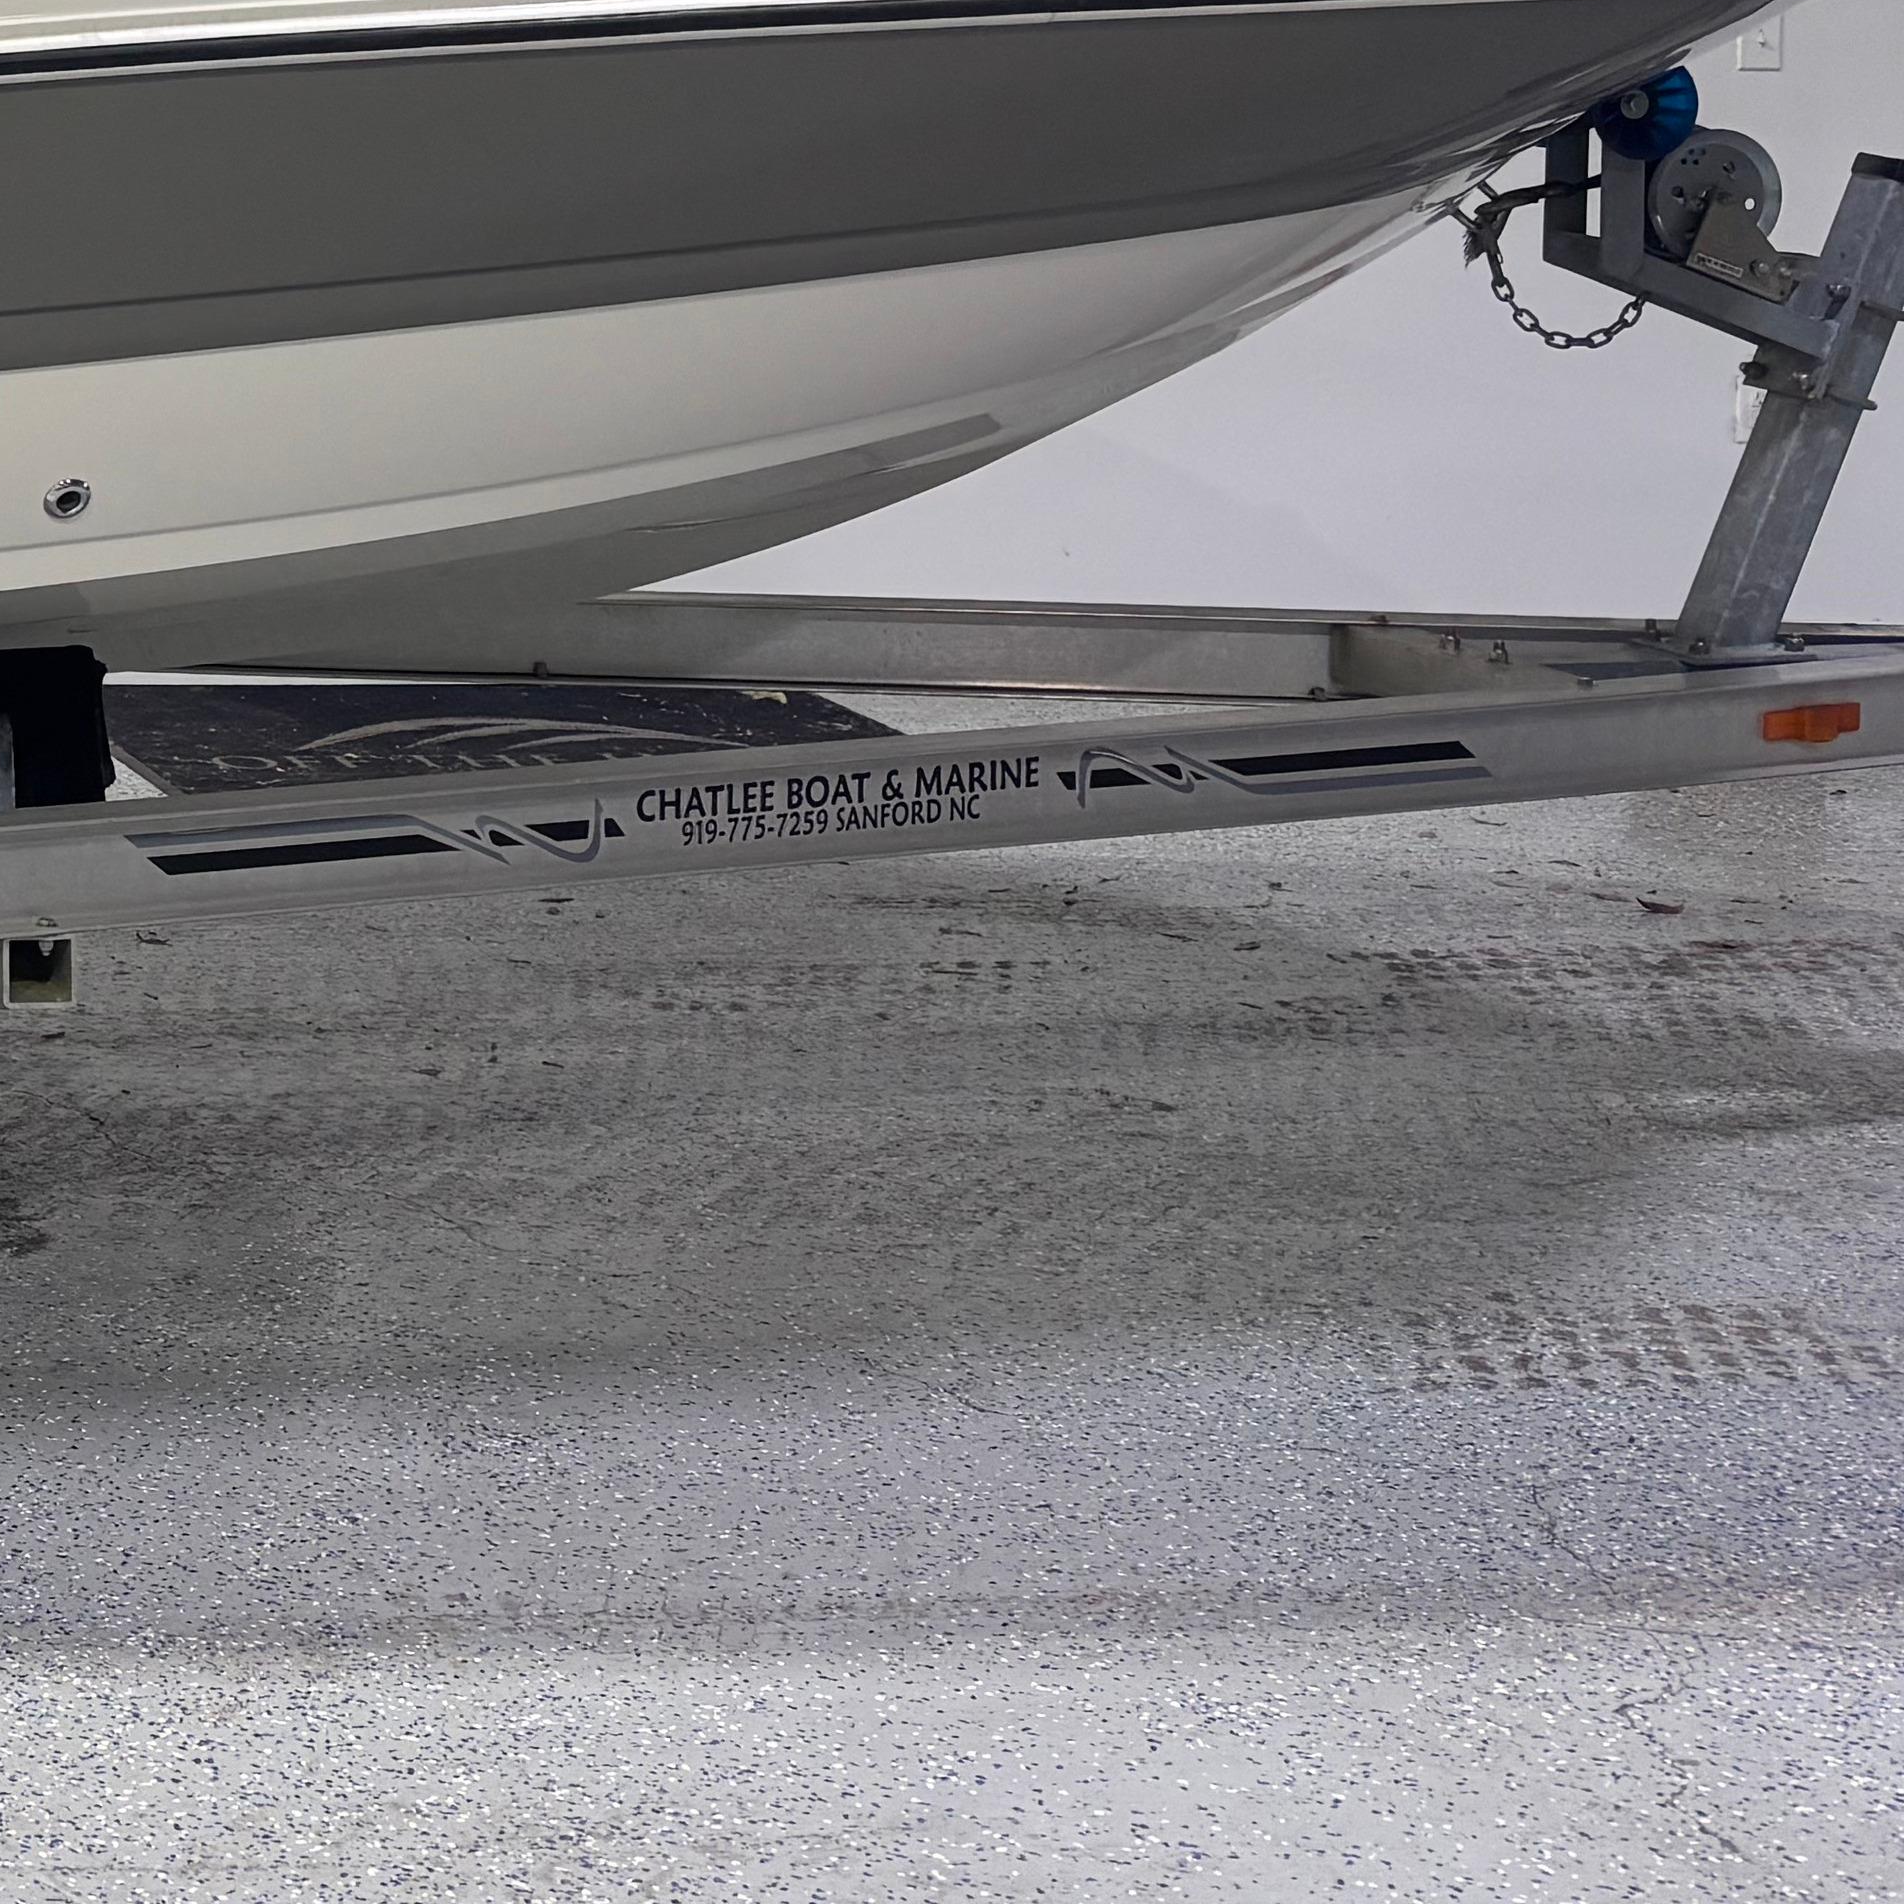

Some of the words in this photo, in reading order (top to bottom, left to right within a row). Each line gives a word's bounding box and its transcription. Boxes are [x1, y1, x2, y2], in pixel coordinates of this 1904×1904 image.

[635, 779, 776, 823] CHATLEE
[786, 771, 872, 810] BOAT
[881, 768, 904, 800] &
[914, 755, 1041, 798] MARINE
[681, 809, 829, 847] 919-775-7259
[835, 798, 942, 833] SANFORD
[949, 794, 981, 820] NC
